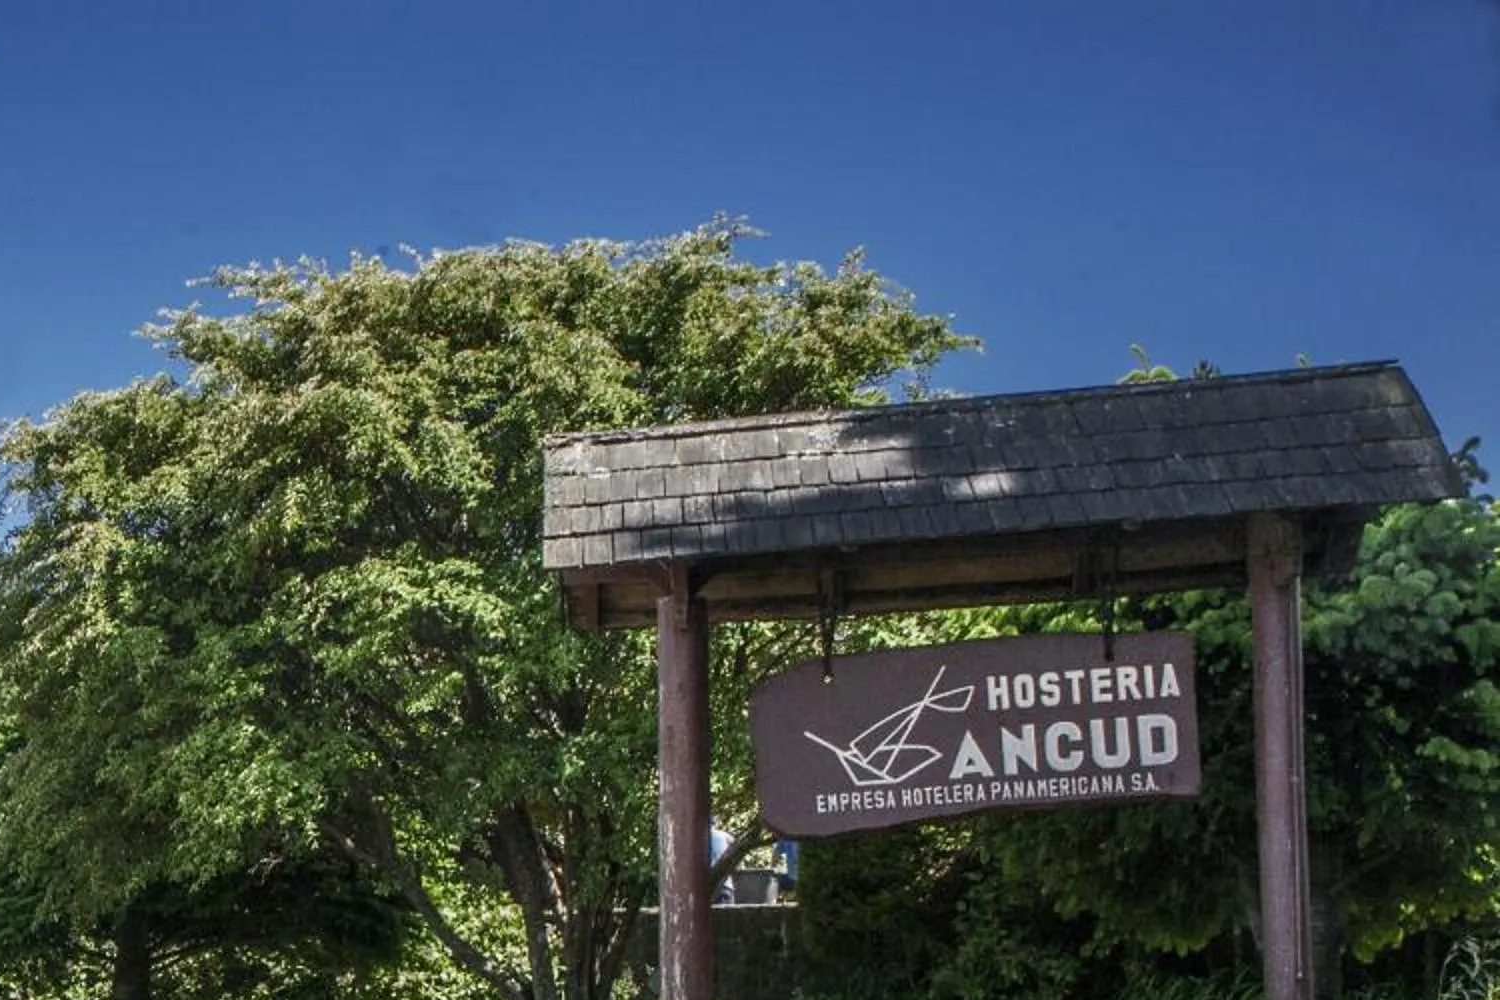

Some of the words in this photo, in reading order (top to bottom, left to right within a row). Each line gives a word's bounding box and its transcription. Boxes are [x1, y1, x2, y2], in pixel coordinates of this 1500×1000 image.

[986, 663, 1181, 711] HOSTERIA
[949, 714, 1179, 779] ANCUD
[816, 787, 896, 813] EMPRESA
[902, 783, 986, 808] HOTELERA
[990, 776, 1125, 801] PANAMERICANA
